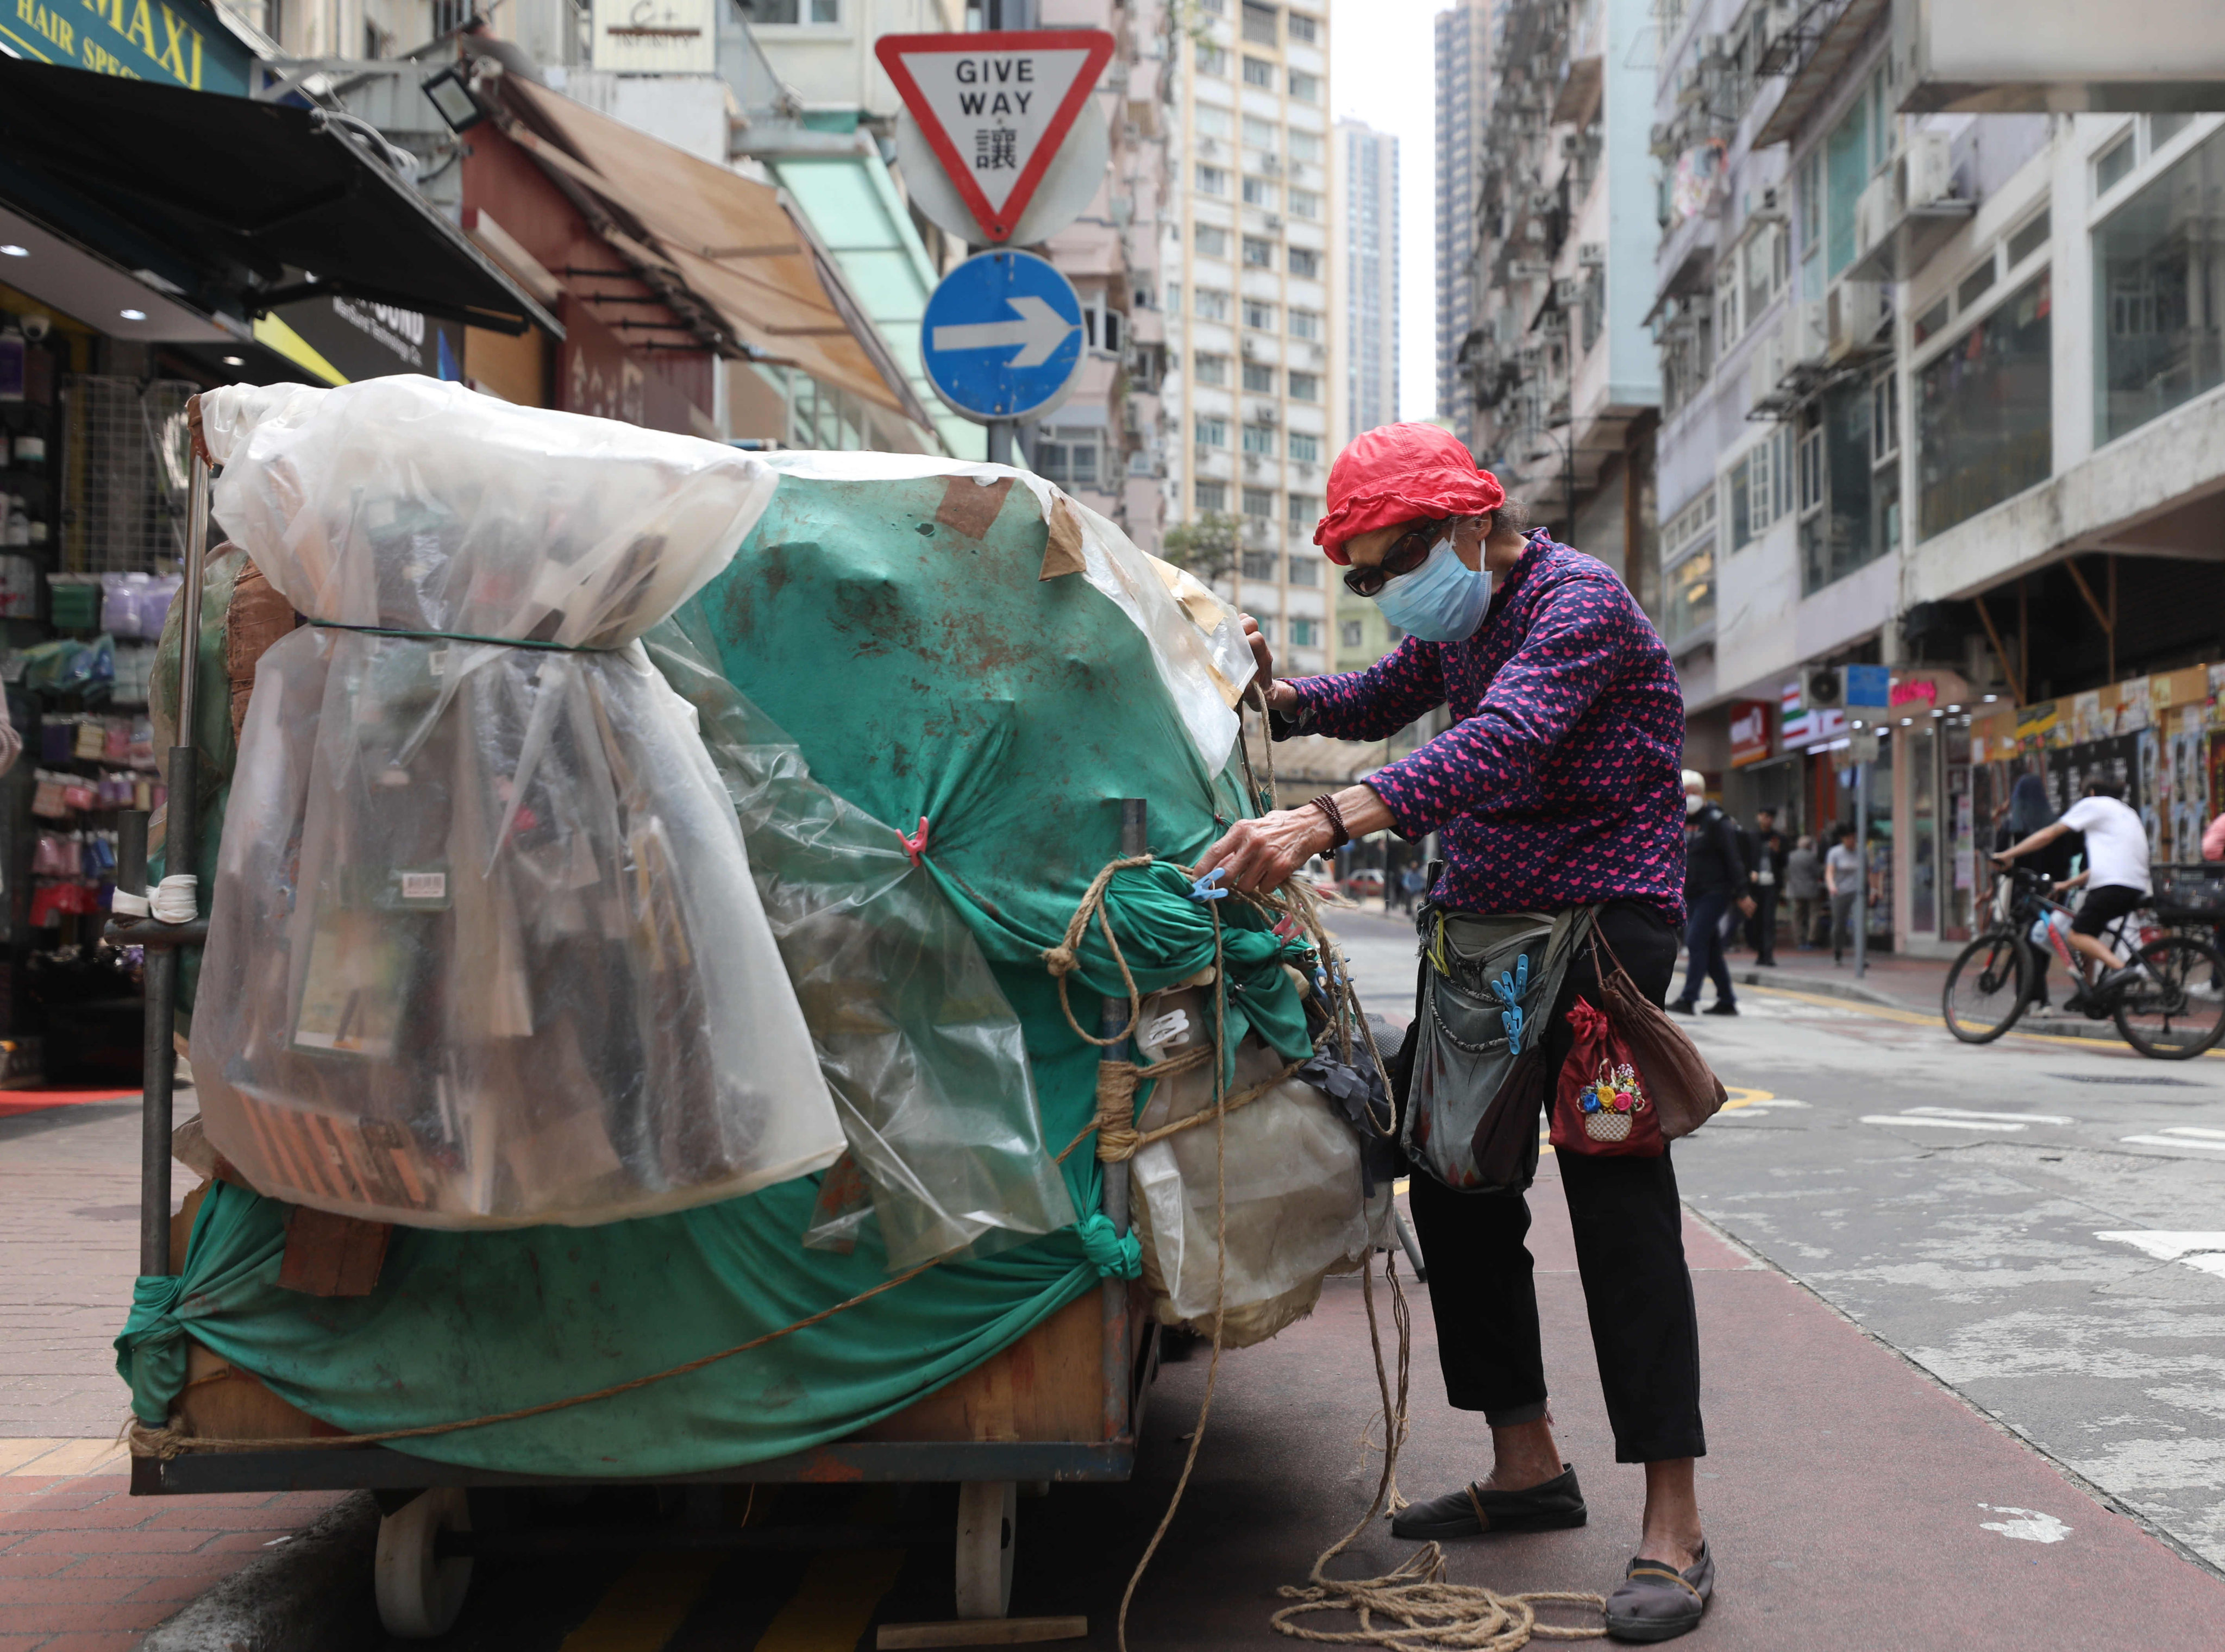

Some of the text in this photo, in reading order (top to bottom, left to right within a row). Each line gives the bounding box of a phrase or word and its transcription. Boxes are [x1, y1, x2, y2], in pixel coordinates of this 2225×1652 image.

[16, 0, 142, 80] HAIR SPE
[956, 59, 1033, 83] GIVE
[960, 91, 1032, 115] WAY
[976, 127, 1017, 170] 讓
